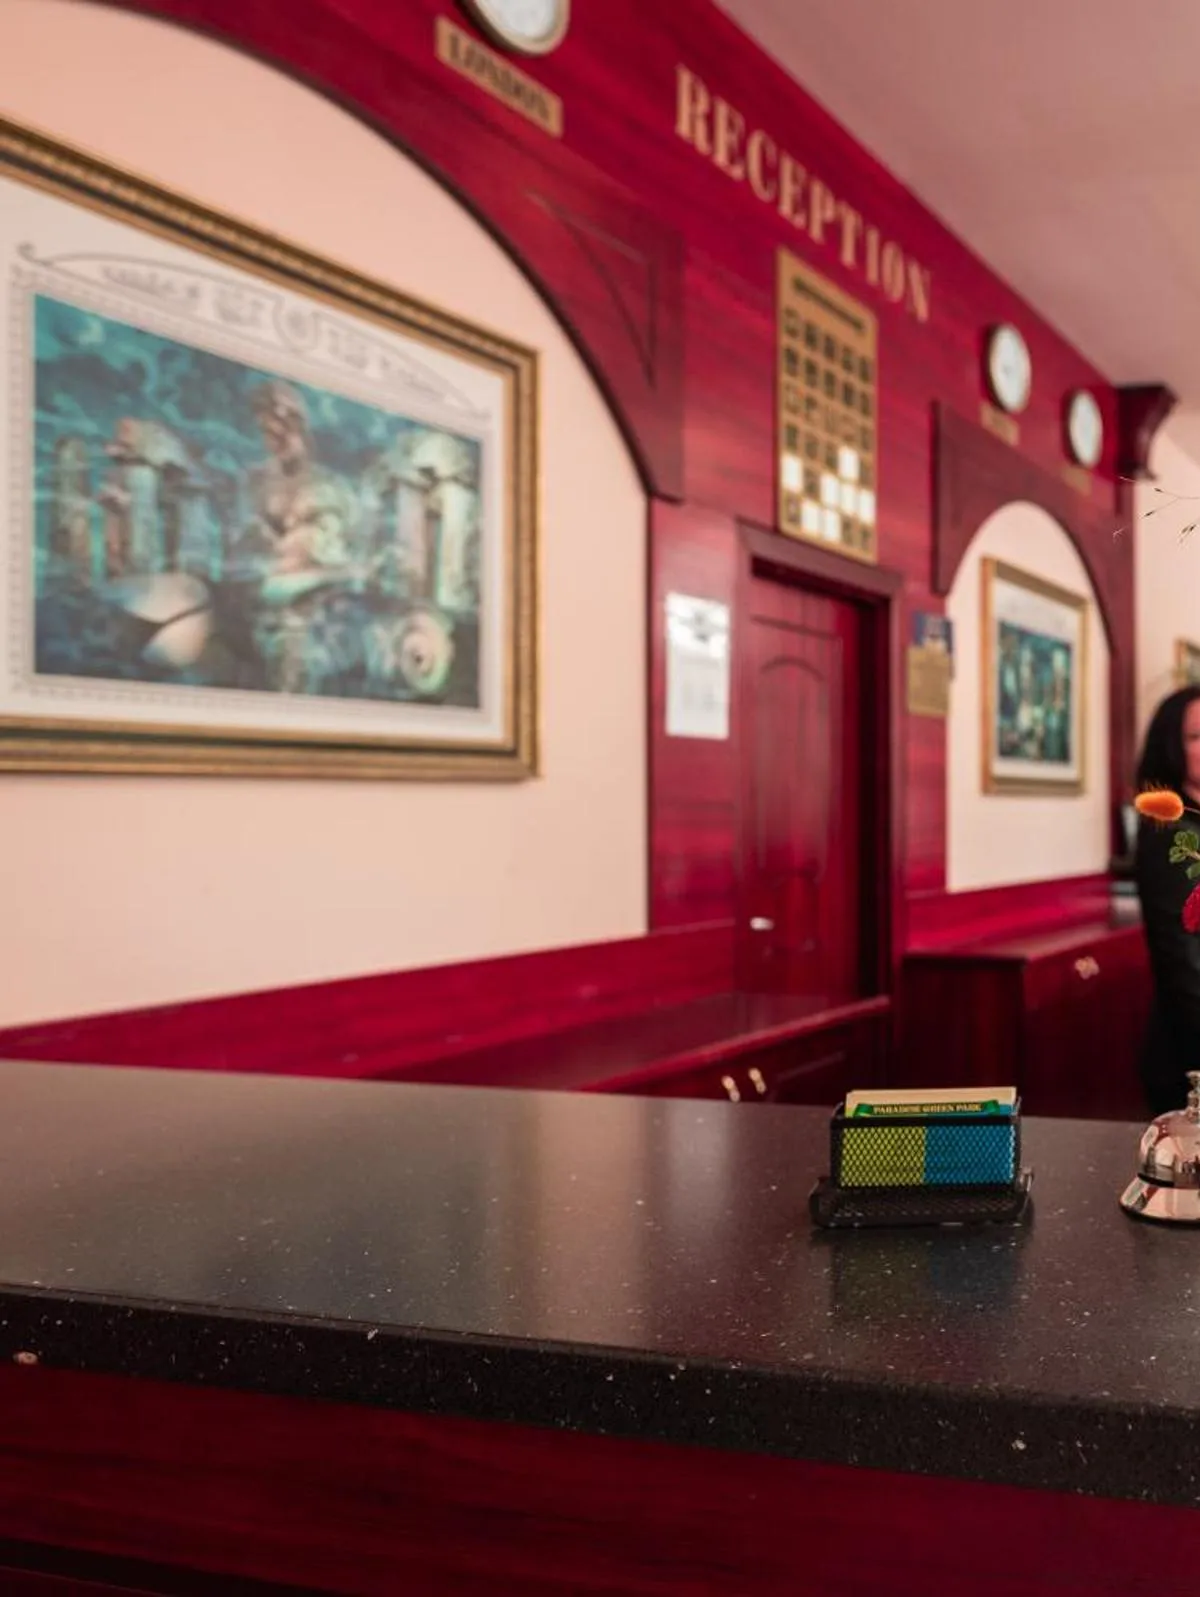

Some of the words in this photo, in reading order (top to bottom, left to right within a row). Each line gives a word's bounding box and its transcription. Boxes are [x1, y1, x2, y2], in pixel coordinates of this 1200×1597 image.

[449, 31, 550, 121] LONDON
[675, 62, 932, 323] RECEPTION
[922, 1103, 955, 1114] GREEN
[956, 1102, 983, 1113] PARK
